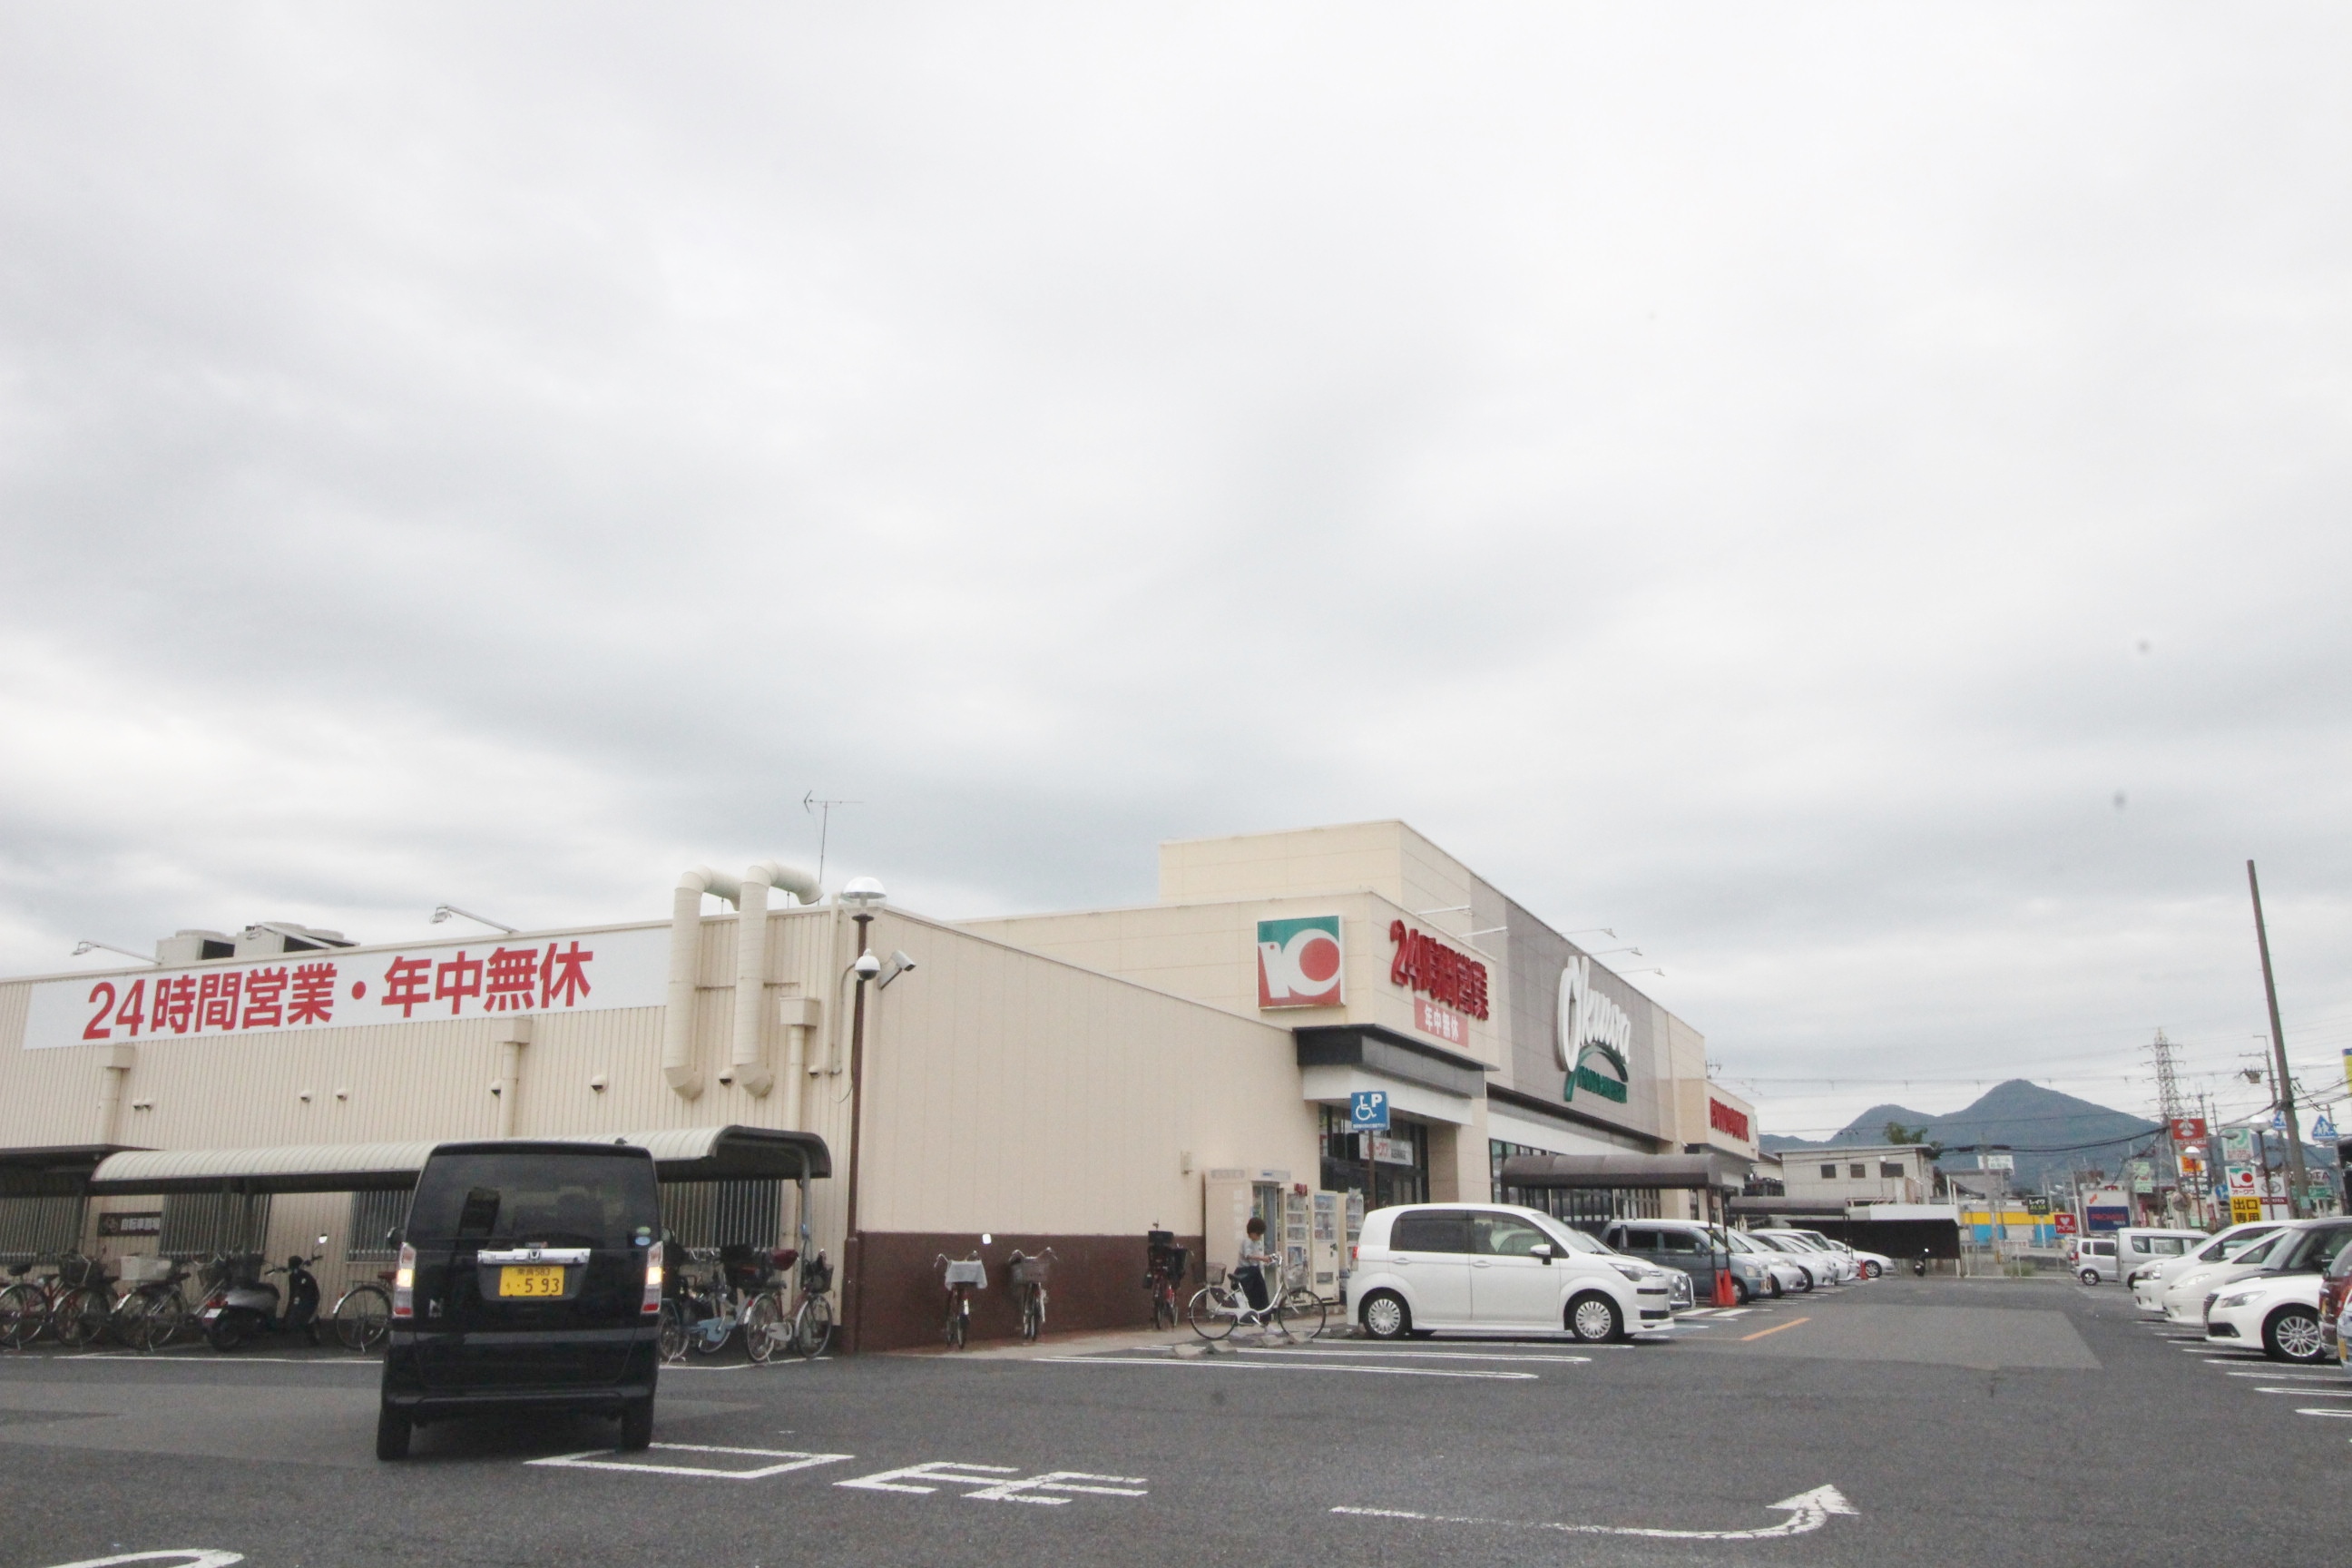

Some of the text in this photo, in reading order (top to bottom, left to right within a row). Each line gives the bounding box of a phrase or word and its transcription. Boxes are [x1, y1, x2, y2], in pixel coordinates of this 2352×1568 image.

[1389, 918, 1489, 1021] 24時間営業
[1424, 1004, 1459, 1042] 年中無休
[1557, 956, 1632, 1073] Okuwa
[1371, 1093, 1384, 1108] P
[2233, 1199, 2259, 1210] 出口
[2235, 1212, 2260, 1223] 専用
